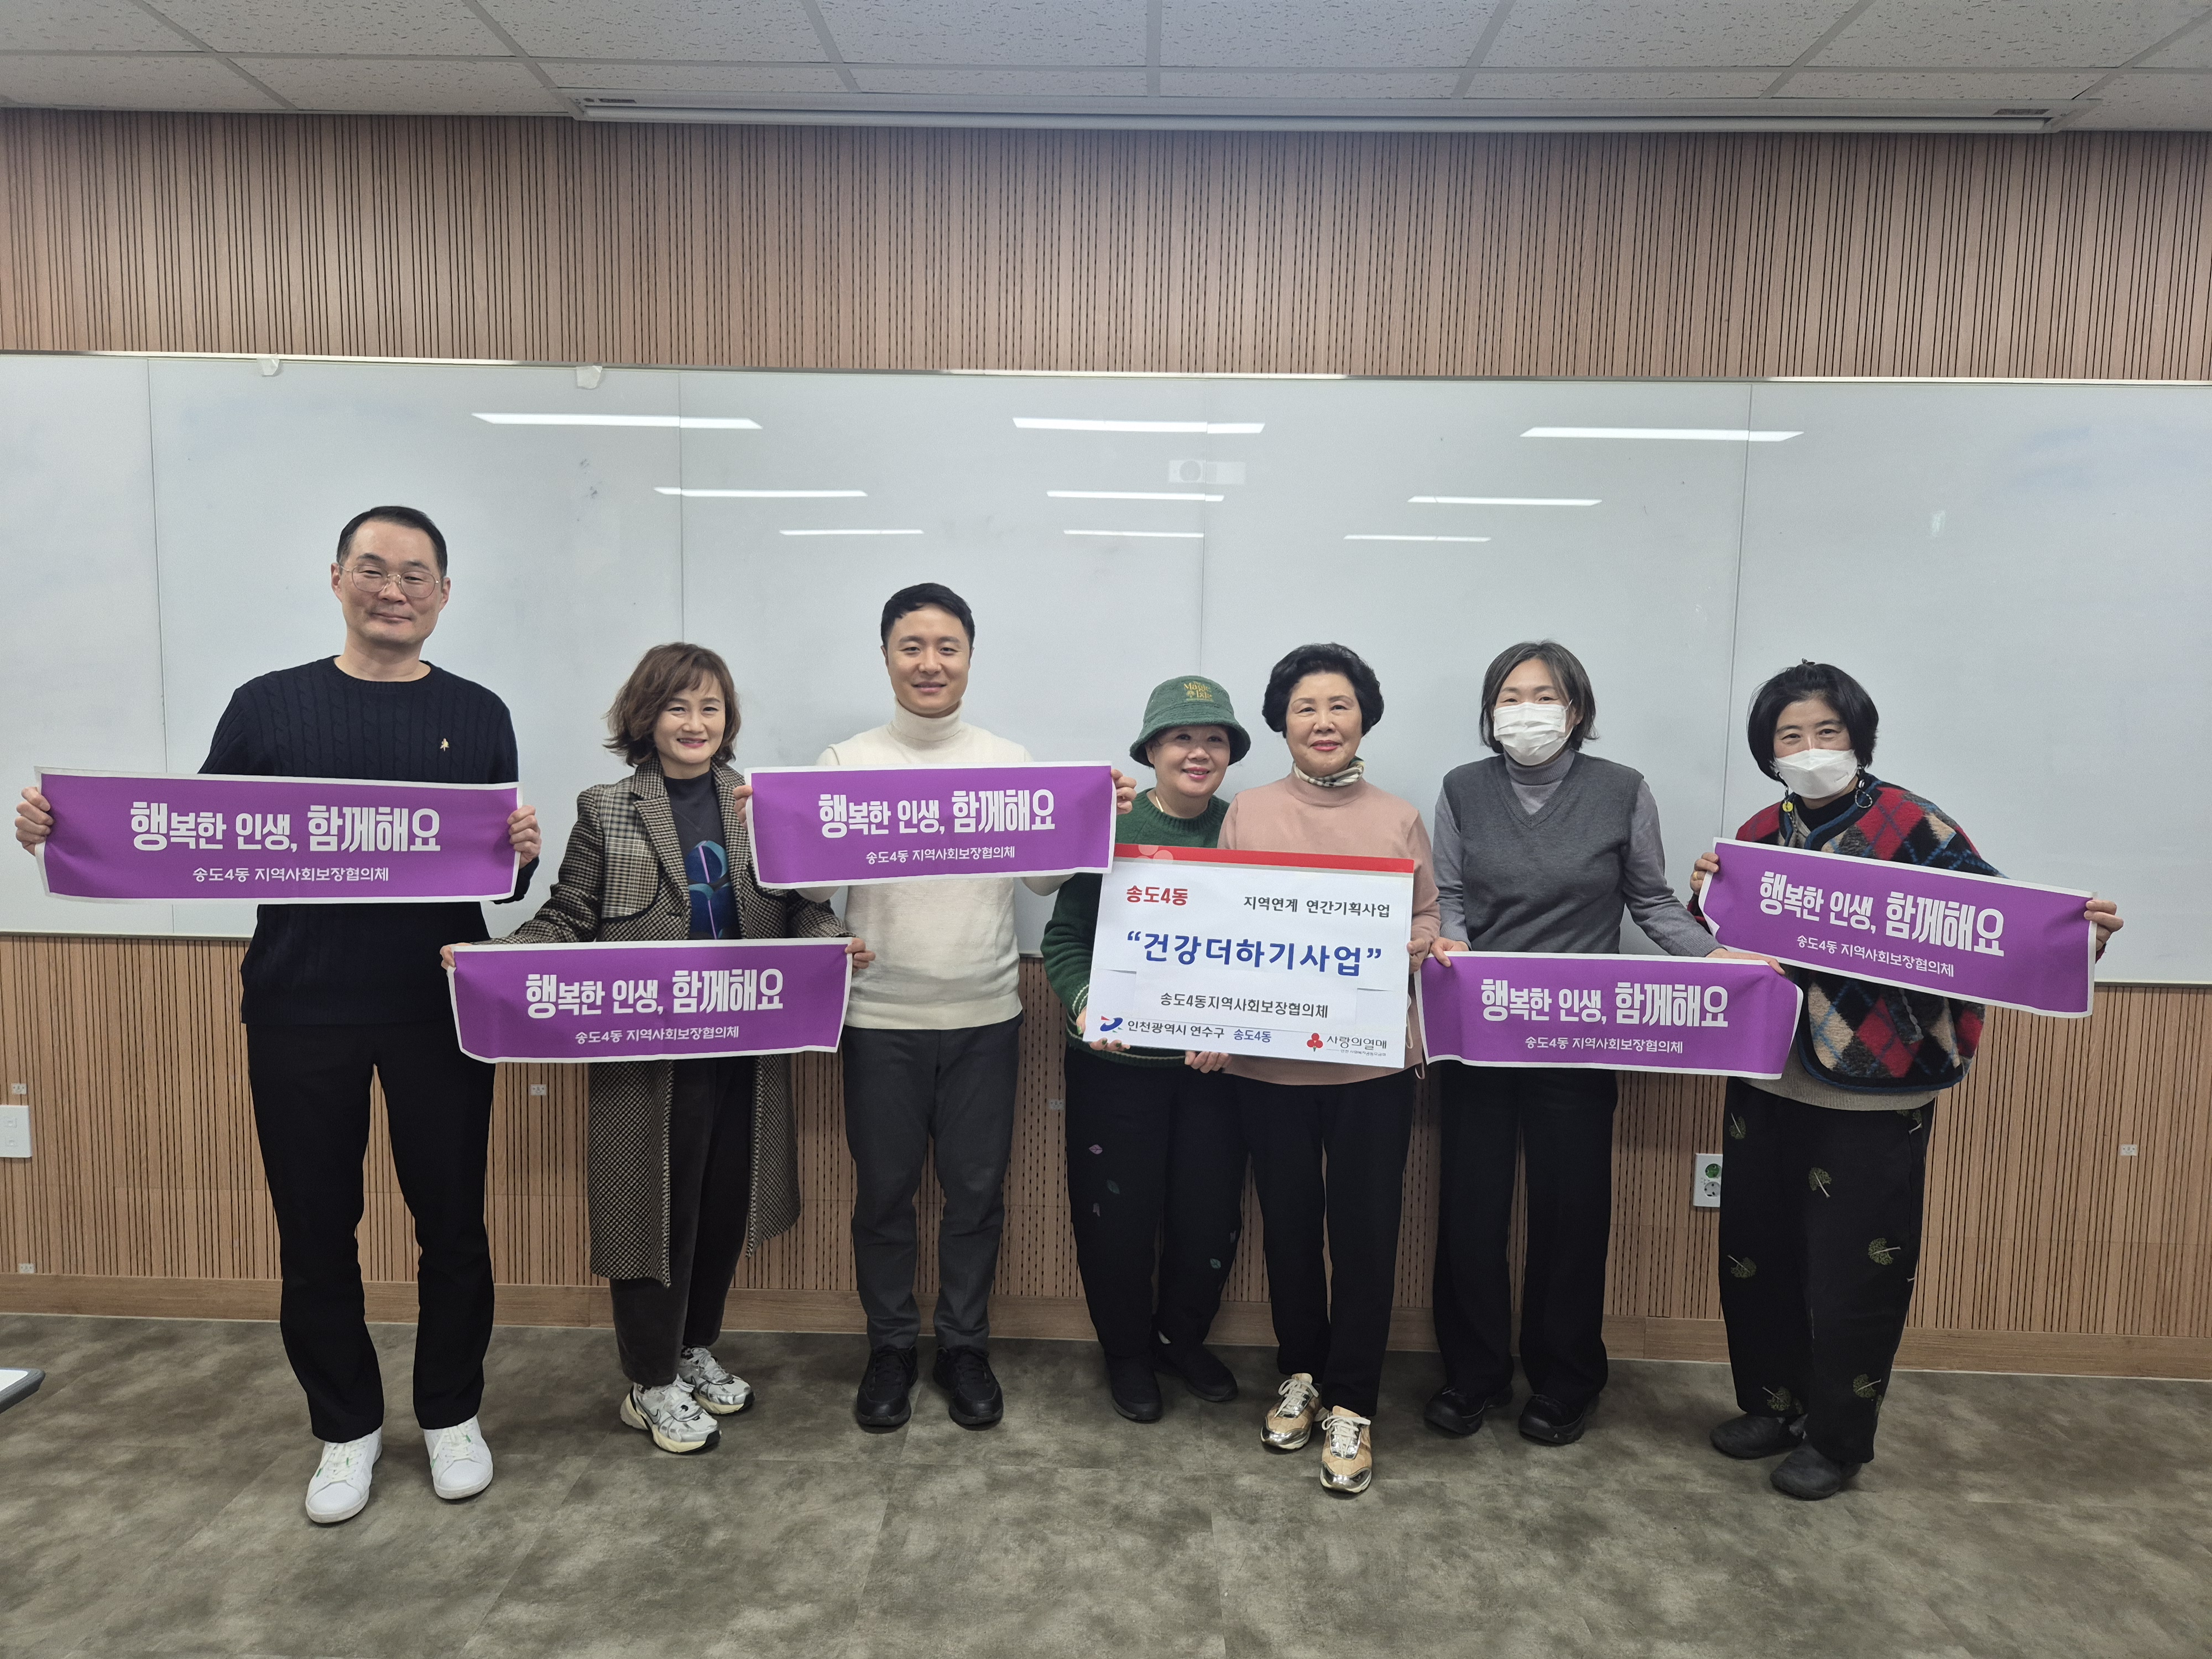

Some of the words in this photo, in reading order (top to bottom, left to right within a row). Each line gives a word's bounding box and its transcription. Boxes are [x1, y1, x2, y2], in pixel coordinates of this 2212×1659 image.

[818, 794, 891, 838] 행복한
[897, 800, 945, 834] 인생,
[951, 789, 1056, 834] 함께해요
[130, 801, 227, 851] 행복한
[236, 813, 298, 853] 인생,
[307, 805, 441, 853] 함께해요
[865, 849, 909, 865] 송도4동
[912, 846, 1015, 862] 지역사회보장협의체
[192, 867, 250, 883] 송도4동
[255, 867, 389, 882] 지역사회보장협의체
[1126, 885, 1188, 906] 송도4동
[1243, 896, 1298, 912] 지역연계
[1306, 900, 1390, 918] 연간기획사업
[1760, 871, 1824, 922] 행복한
[1829, 891, 1876, 934] 인생,
[1885, 891, 2005, 957] 함께해요
[1797, 935, 1838, 954] 송도4동
[1841, 943, 1954, 978] 지역사회보장협의체
[525, 974, 606, 1019] 행복한
[612, 979, 664, 1015] 인생,
[672, 968, 784, 1014] 함께해요
[1480, 979, 1552, 1021] 행복한
[1558, 988, 1607, 1025] 인생,
[1615, 982, 1728, 1027] 함께해요
[1160, 992, 1328, 1019] 송도4동지역사회보장협의체
[575, 1030, 623, 1045] 송도4동
[626, 1025, 739, 1042] 지역사회보장협의체
[1128, 1020, 1187, 1036] 인천광역시
[1190, 1022, 1225, 1039] 연수구
[1233, 1029, 1272, 1043] 송도4동
[1326, 1035, 1387, 1051] 사랑의열매
[1525, 1036, 1569, 1050] 송도4동
[1572, 1037, 1683, 1054] 지역사회보장협의체
